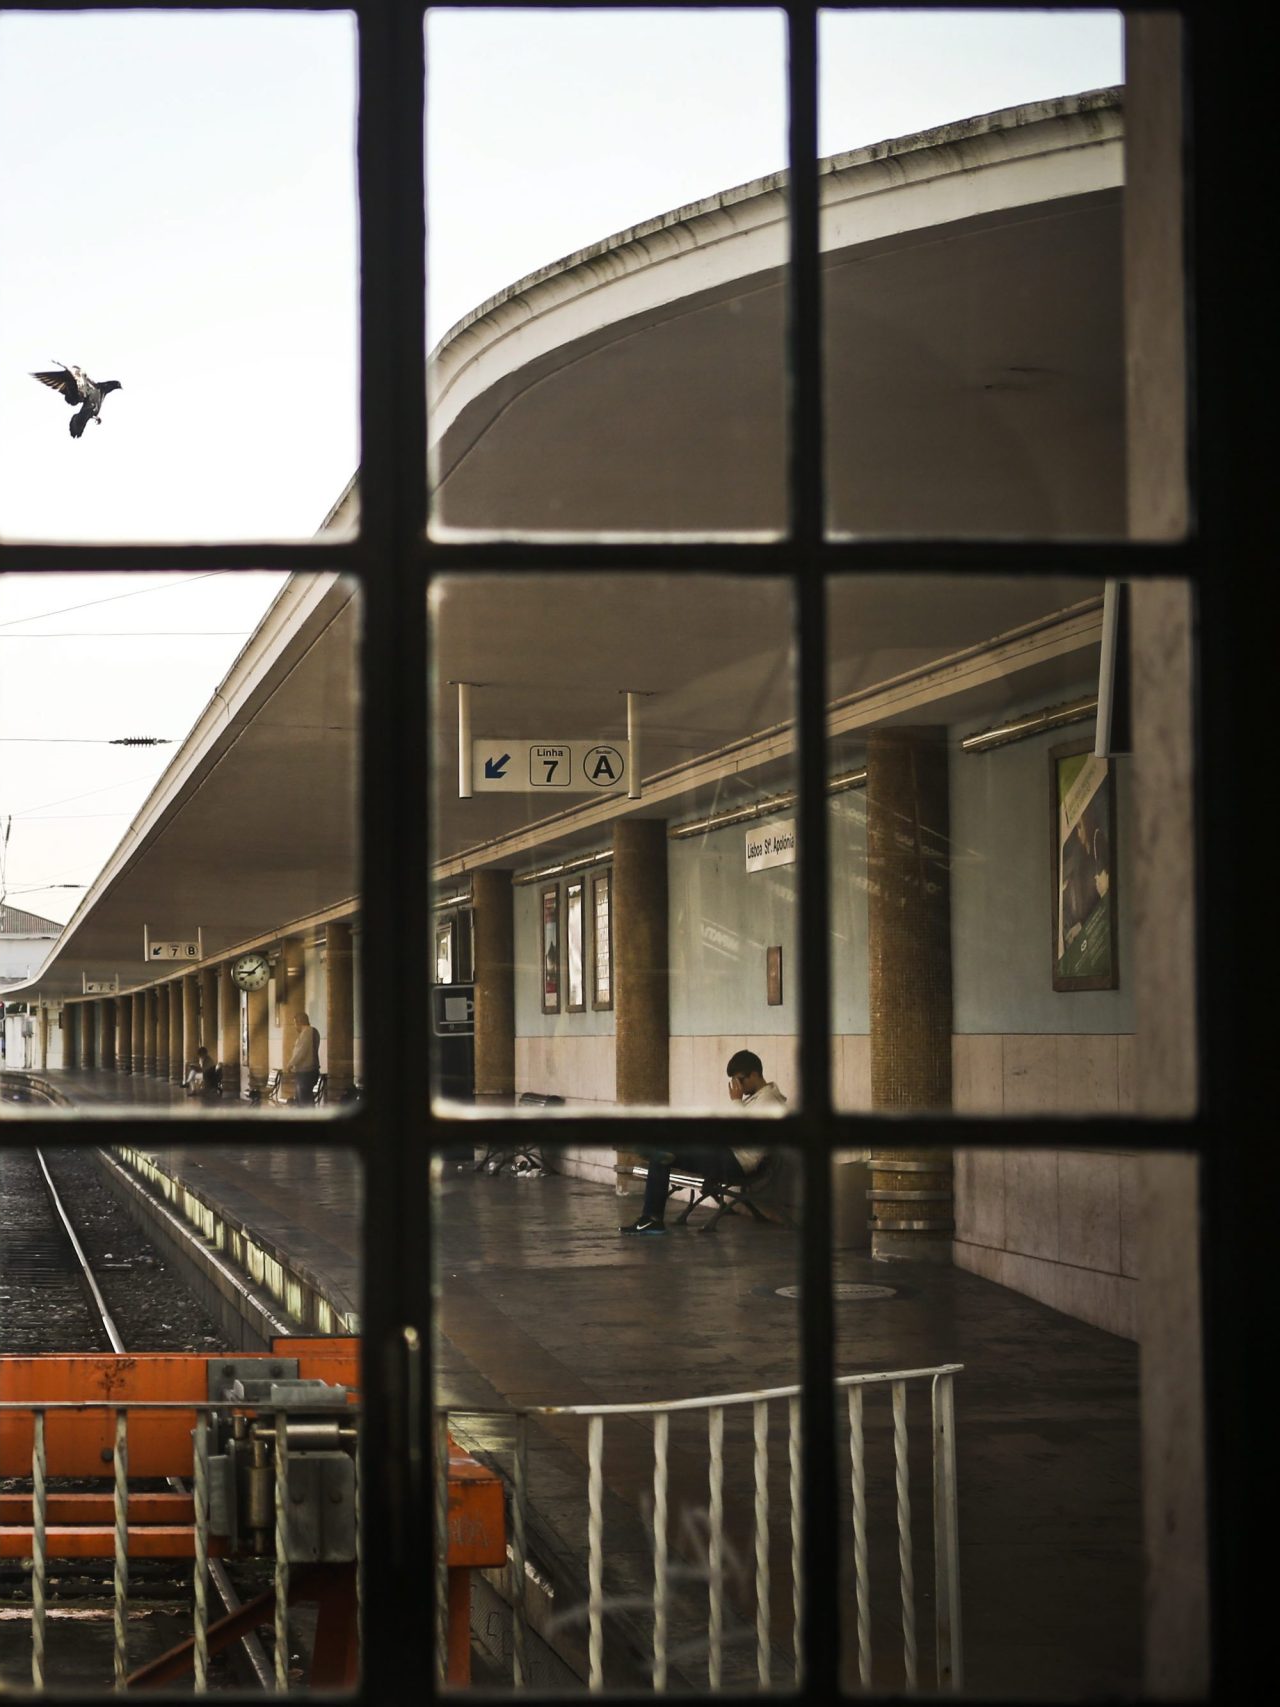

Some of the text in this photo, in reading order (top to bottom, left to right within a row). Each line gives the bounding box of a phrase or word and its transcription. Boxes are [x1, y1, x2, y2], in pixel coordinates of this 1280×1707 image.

[537, 749, 563, 757] Linha
[543, 761, 559, 783] 7
[592, 755, 615, 779] A
[747, 842, 762, 859] Lisboa
[172, 946, 195, 957] 7 B
